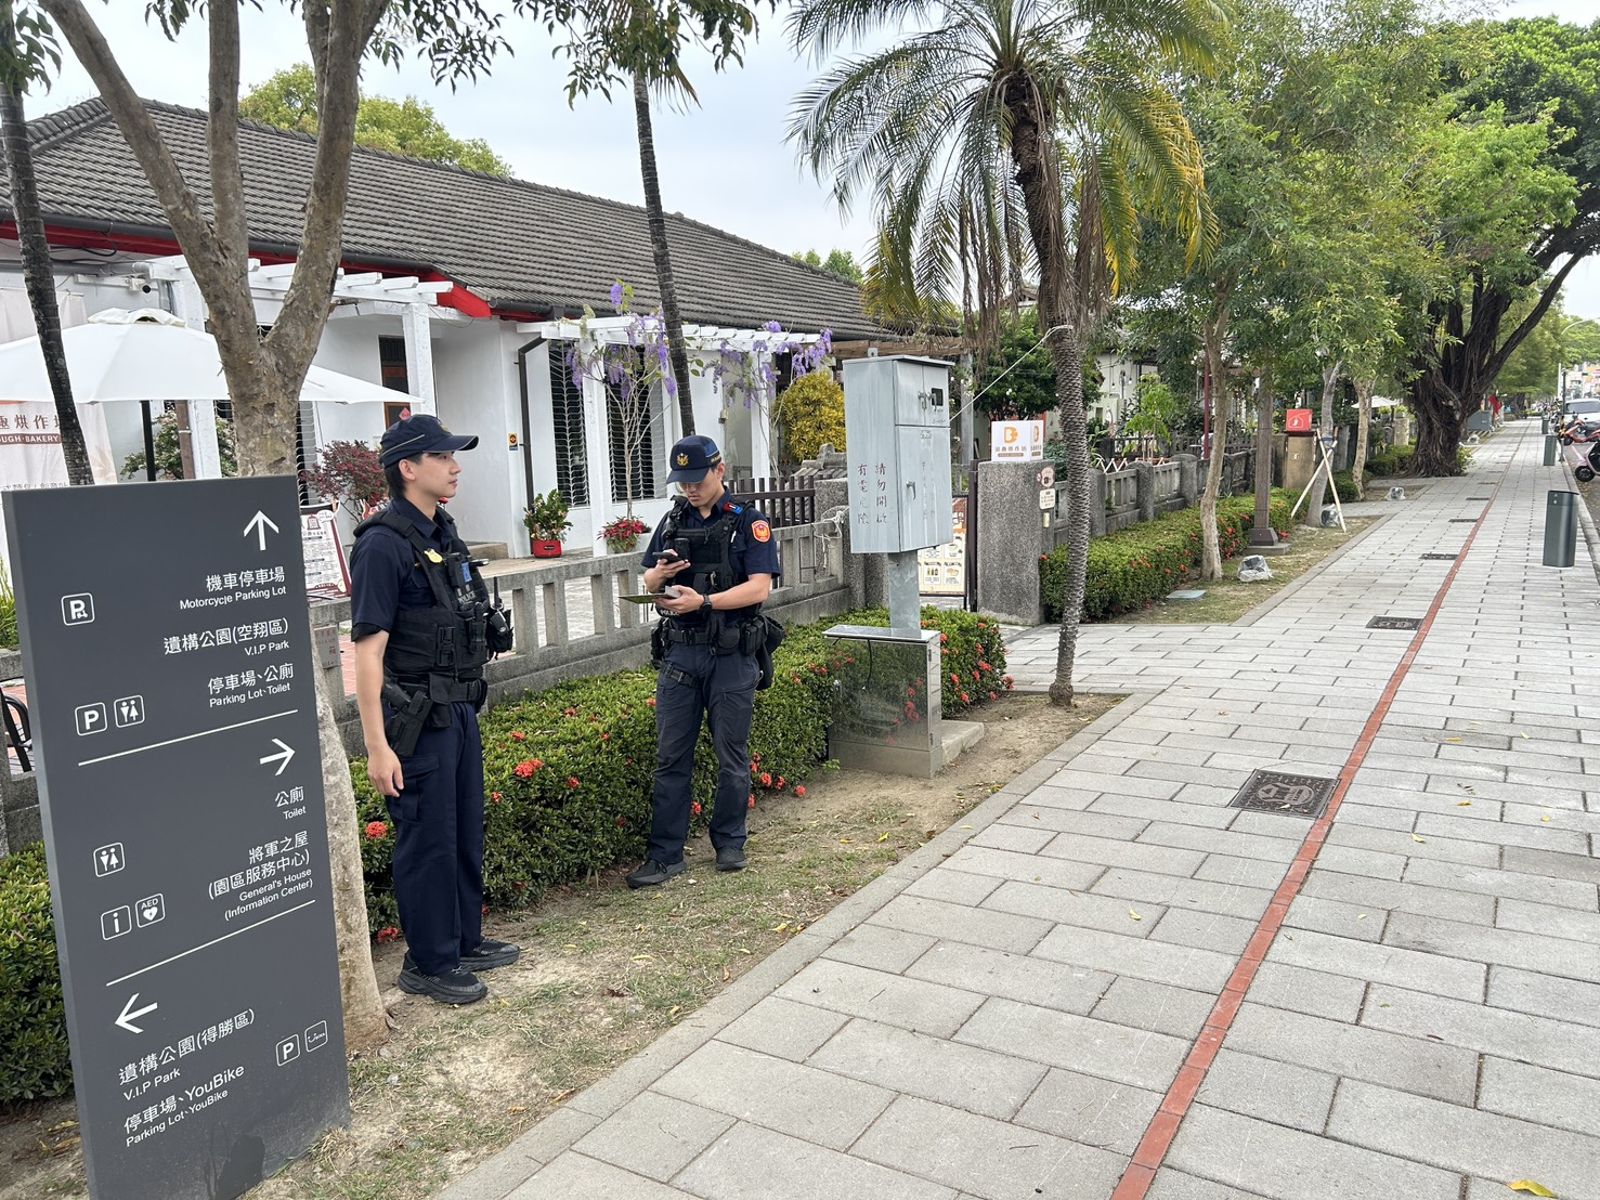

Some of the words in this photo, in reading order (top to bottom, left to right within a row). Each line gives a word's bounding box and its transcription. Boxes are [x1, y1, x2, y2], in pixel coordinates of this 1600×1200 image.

[26, 435, 59, 443] BAKERY
[206, 566, 285, 592] 機車停車場
[180, 595, 233, 610] Motorcycle
[235, 589, 271, 602] Parking
[272, 586, 287, 595] Lot
[164, 617, 289, 655] 遺構公園(空翔區)
[244, 643, 266, 656] V.I.P
[268, 640, 290, 652] Park
[209, 693, 246, 708] Parking
[275, 786, 304, 808] 公廁
[283, 806, 307, 820] Toilet
[248, 830, 309, 865] 將軍之屋
[208, 848, 310, 900] (園區服務中心)
[239, 880, 282, 901] General's
[284, 869, 312, 885] House
[141, 898, 159, 910] AED
[224, 893, 279, 921] (Information
[281, 878, 314, 897] Center)
[119, 1008, 255, 1085] 遺構公園(得勝區)
[123, 1081, 151, 1101] V.I.P
[154, 1068, 181, 1087] Park
[126, 1122, 166, 1147] Parking
